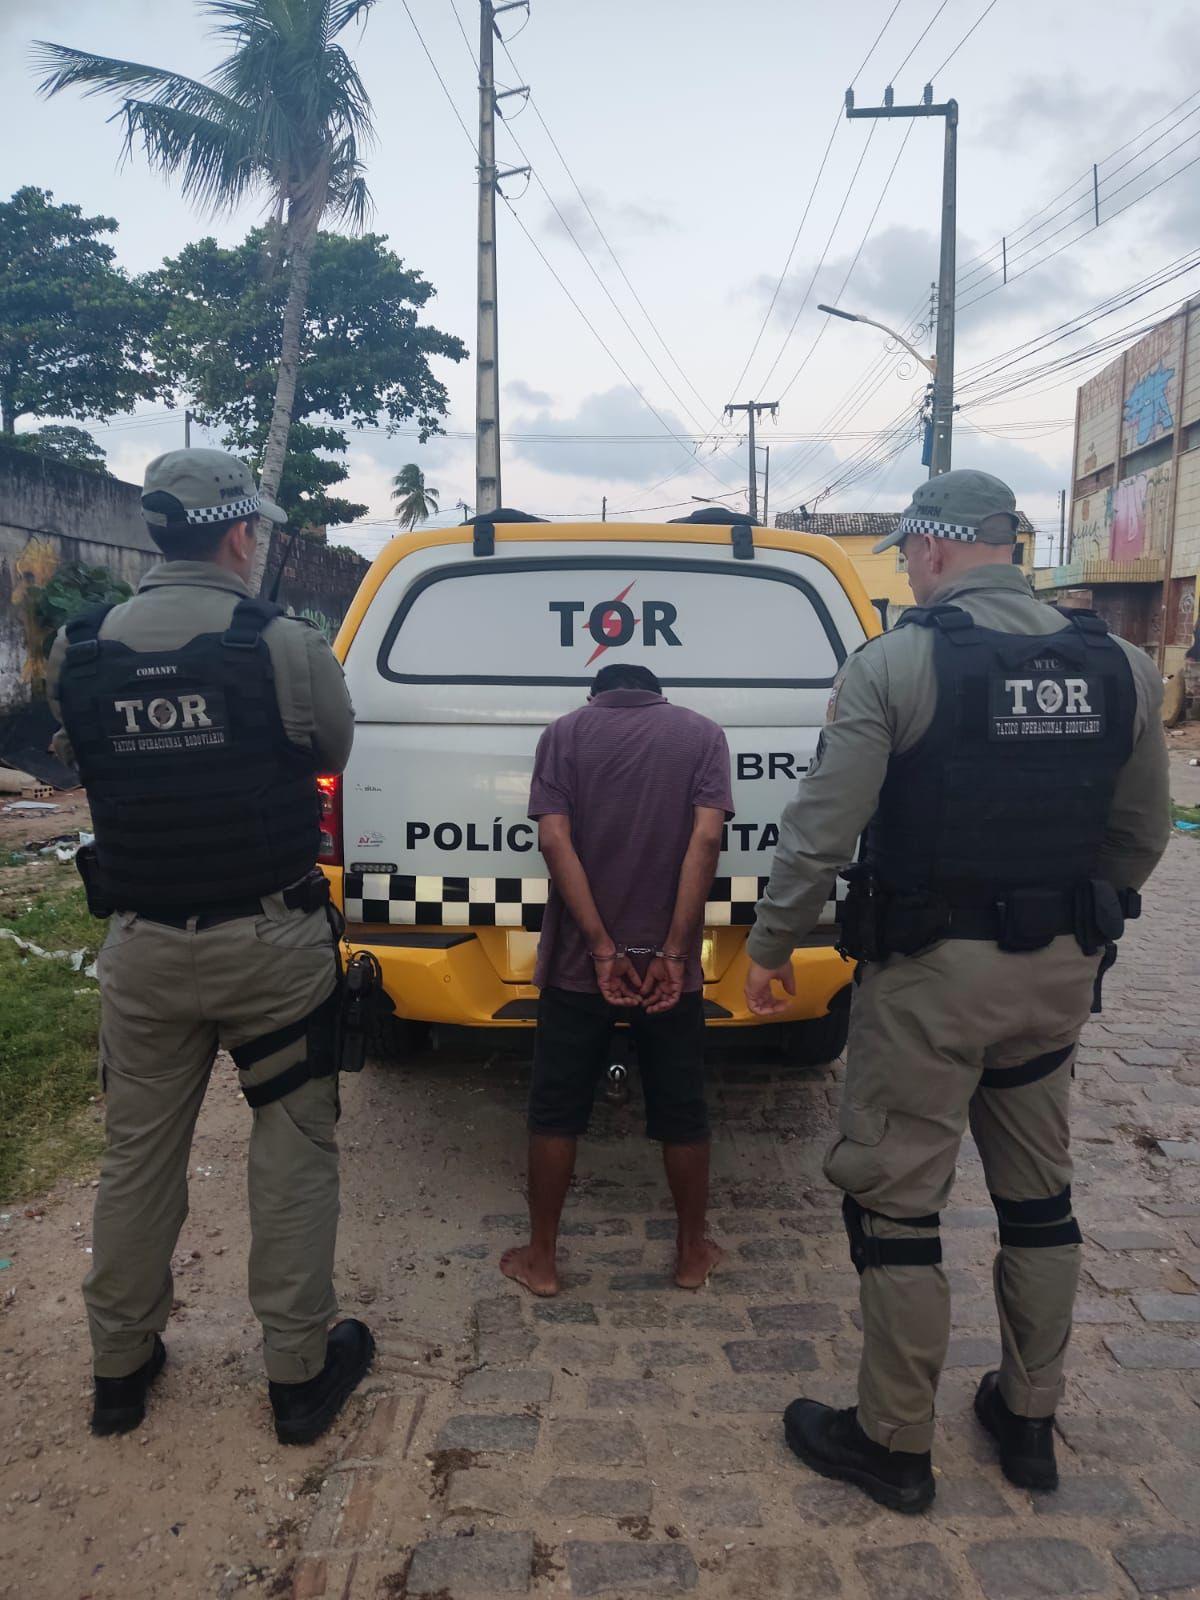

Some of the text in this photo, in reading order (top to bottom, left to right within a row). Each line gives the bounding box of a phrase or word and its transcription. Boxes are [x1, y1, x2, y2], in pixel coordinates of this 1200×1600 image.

[549, 600, 683, 647] TOR
[114, 694, 212, 733] TOR
[1005, 678, 1092, 714] TOR
[737, 752, 809, 780] BR-
[406, 817, 543, 852] POLÍC
[719, 823, 780, 852] ITA
